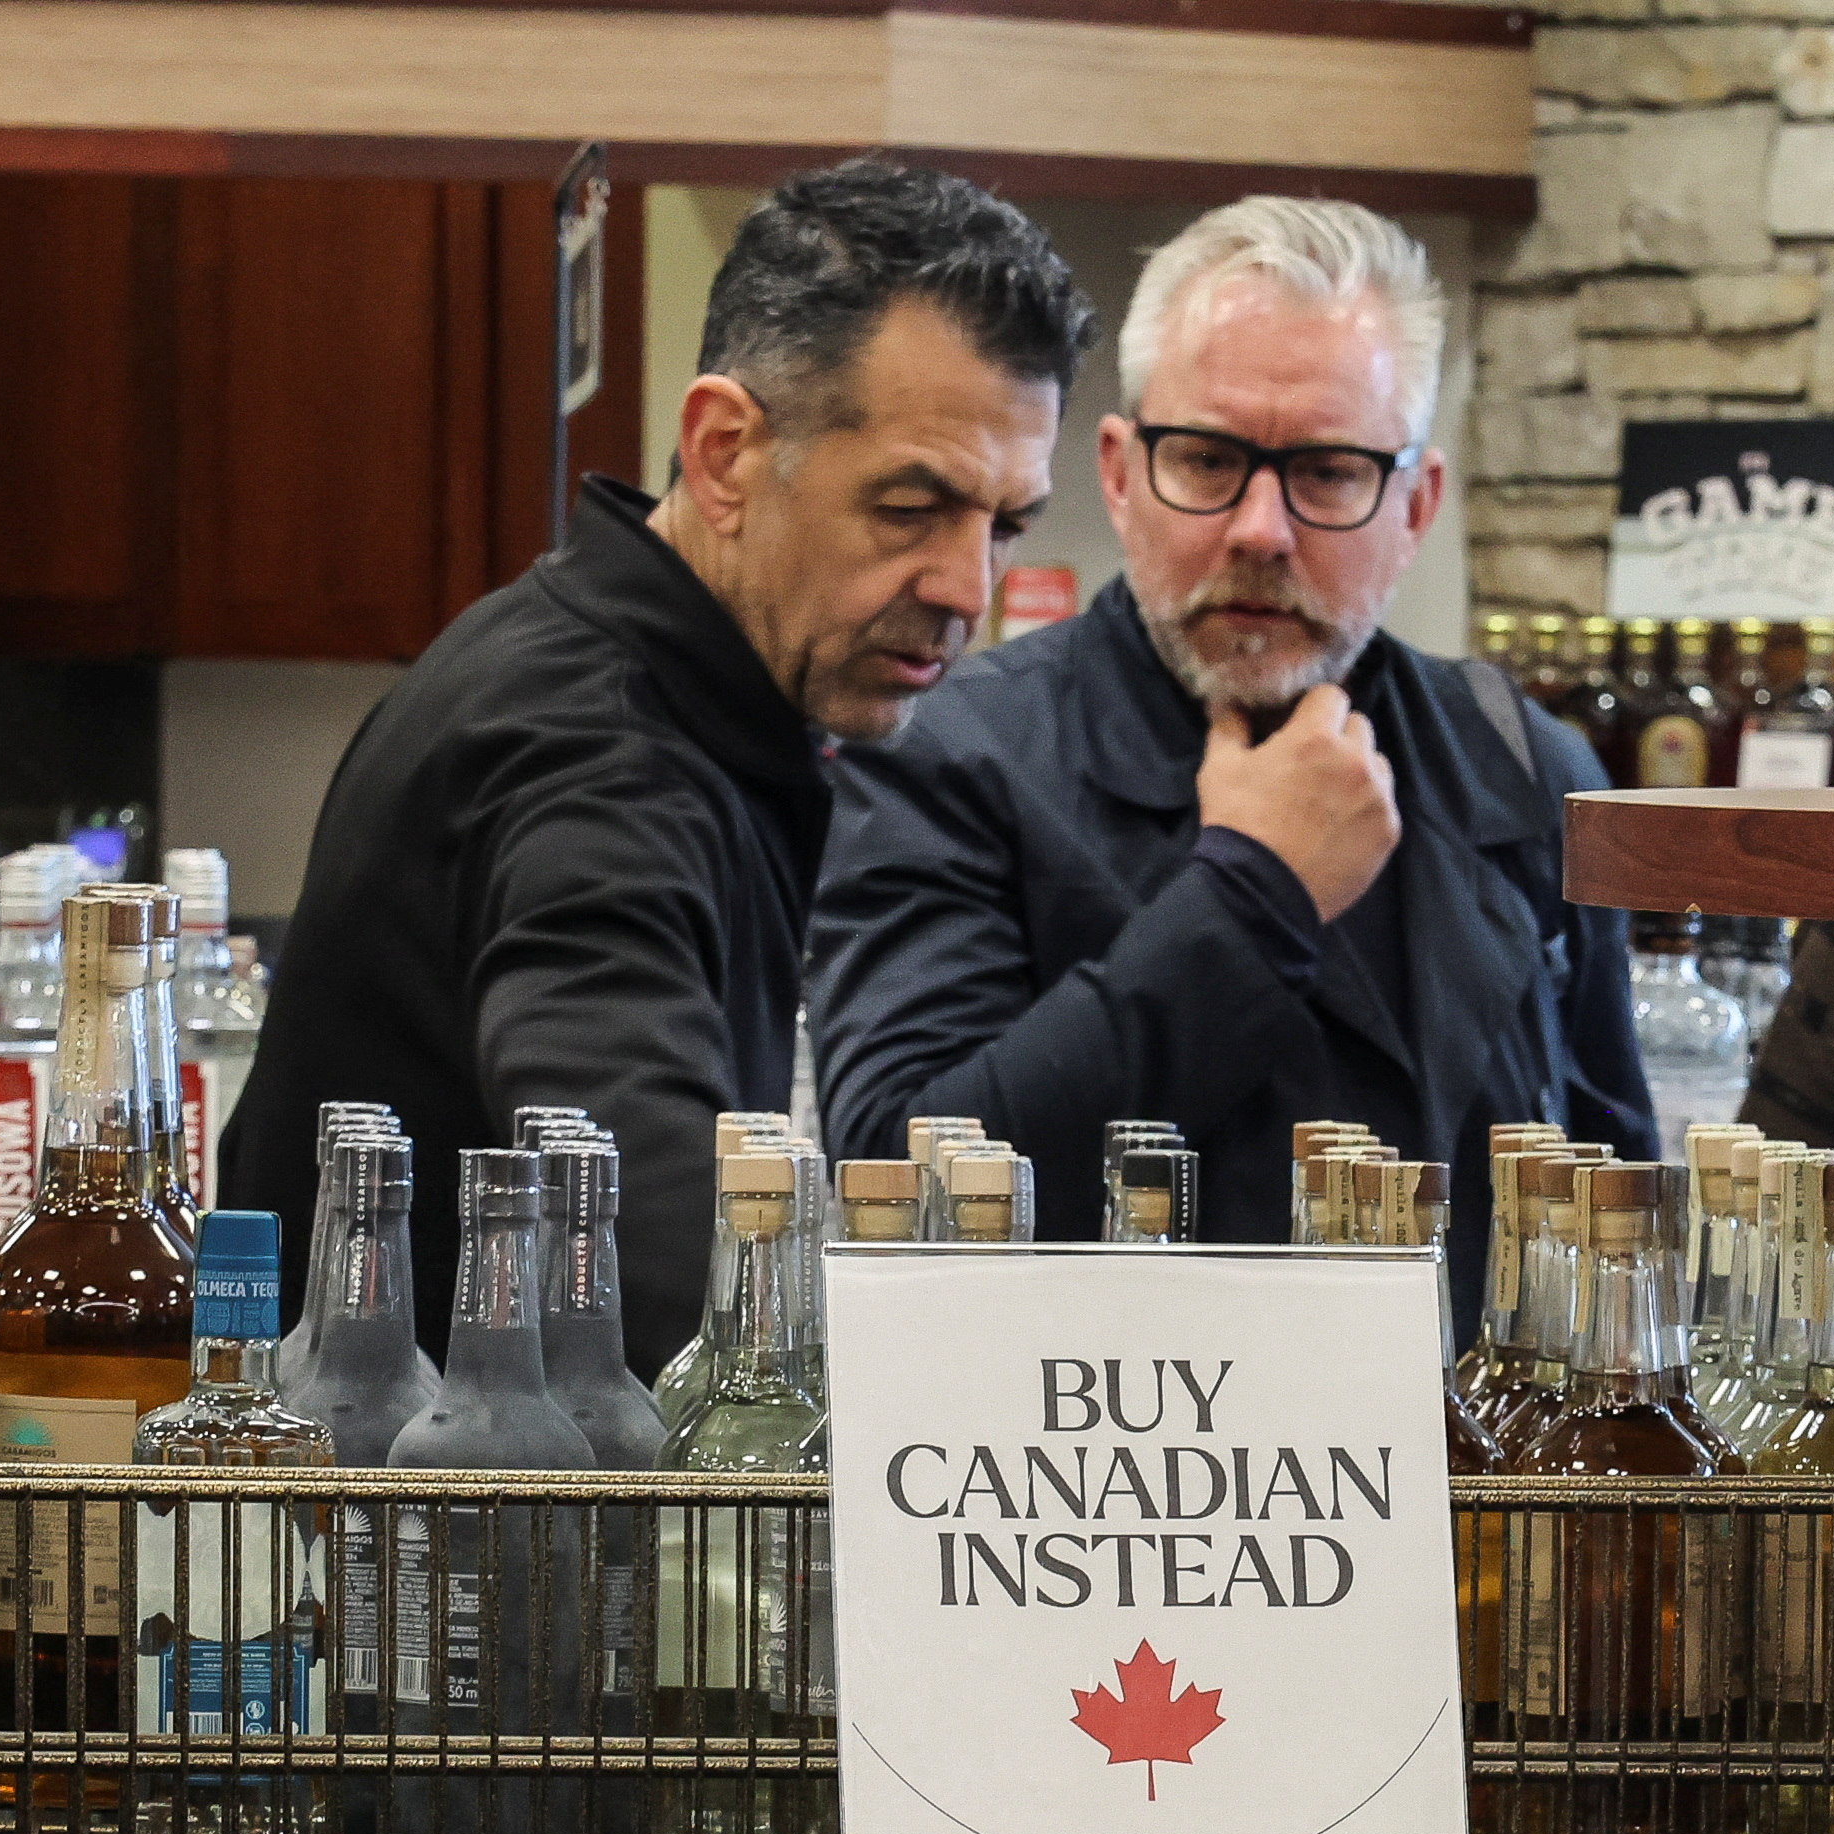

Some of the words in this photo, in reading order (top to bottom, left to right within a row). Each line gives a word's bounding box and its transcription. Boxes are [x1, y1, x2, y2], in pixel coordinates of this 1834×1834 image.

[577, 1152, 590, 1227] CASAMIGO
[197, 1279, 246, 1298] OLMECA
[251, 1281, 279, 1299] TEQU
[1040, 1358, 1234, 1433] BUY
[886, 1443, 1392, 1520] CANADIAN
[938, 1532, 1354, 1608] INSTEAD
